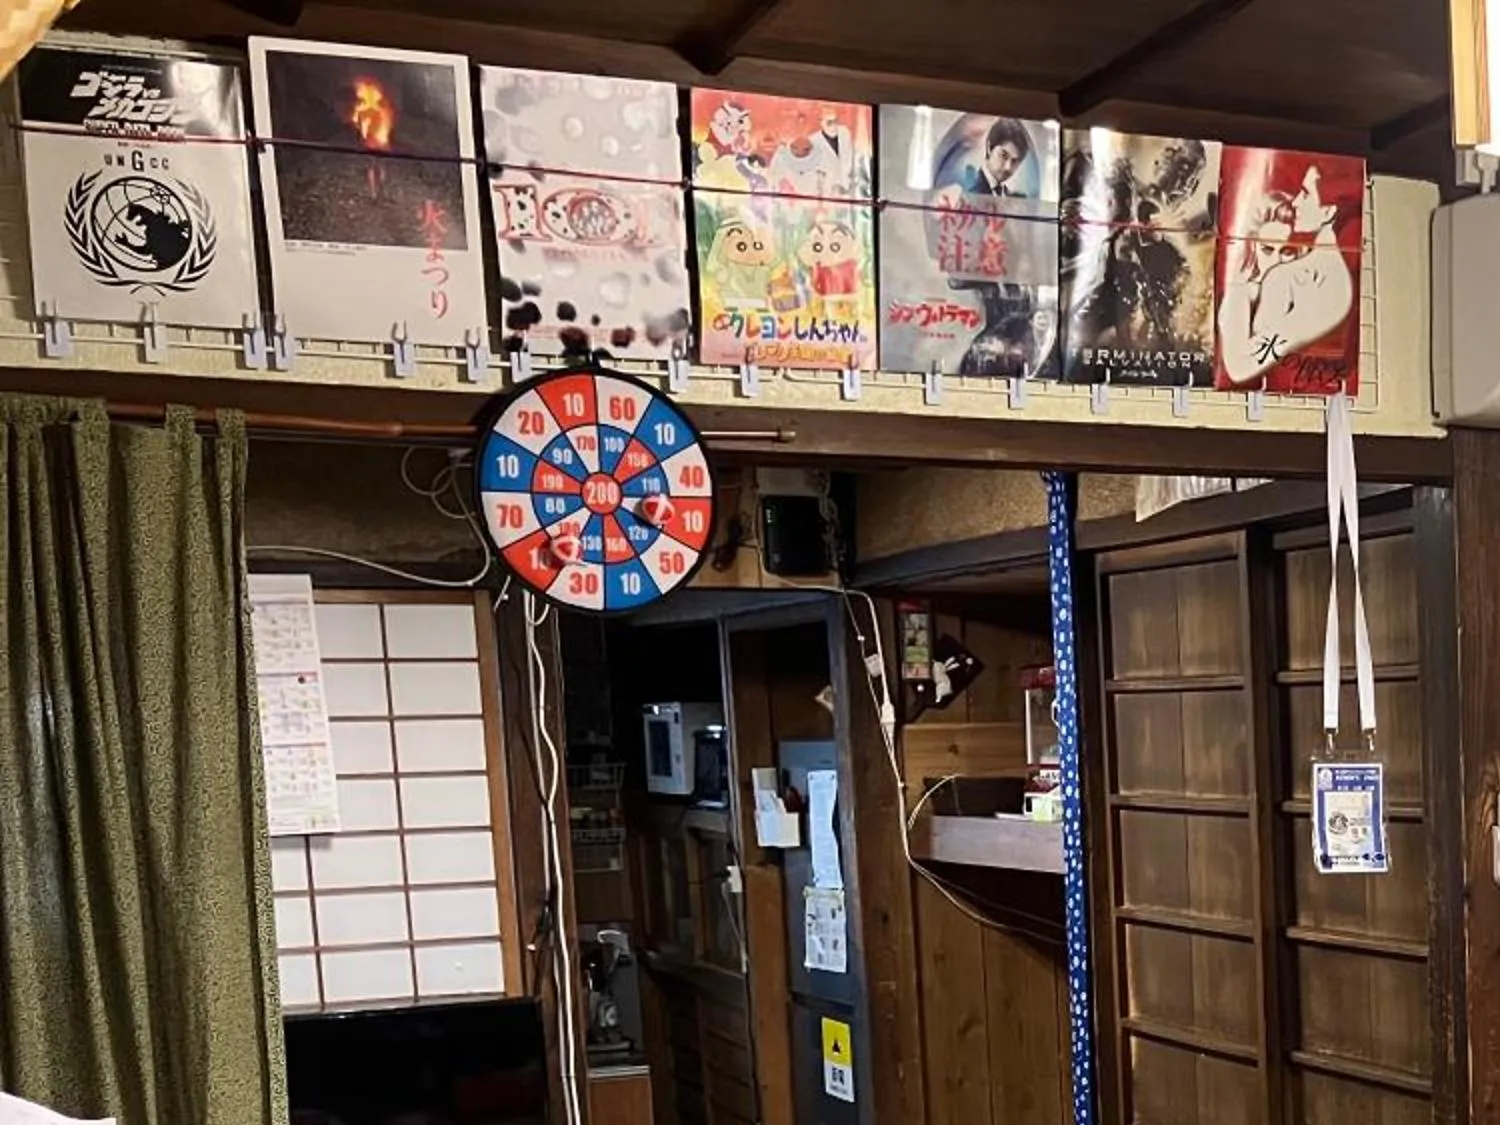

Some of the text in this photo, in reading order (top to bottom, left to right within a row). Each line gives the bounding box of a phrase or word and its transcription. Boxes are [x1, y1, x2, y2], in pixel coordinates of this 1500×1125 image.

[562, 393, 585, 417] 10
[609, 396, 635, 422] 60
[517, 410, 545, 435] 20
[654, 422, 676, 446] 10
[552, 447, 573, 466] 90
[603, 437, 625, 453] 100
[496, 454, 519, 479] 10
[679, 465, 704, 488] 40
[586, 480, 617, 505] 200
[496, 504, 523, 529] 70
[681, 511, 703, 533] 10
[658, 551, 685, 575] 50
[568, 572, 599, 595] 30
[619, 572, 641, 595] 10
